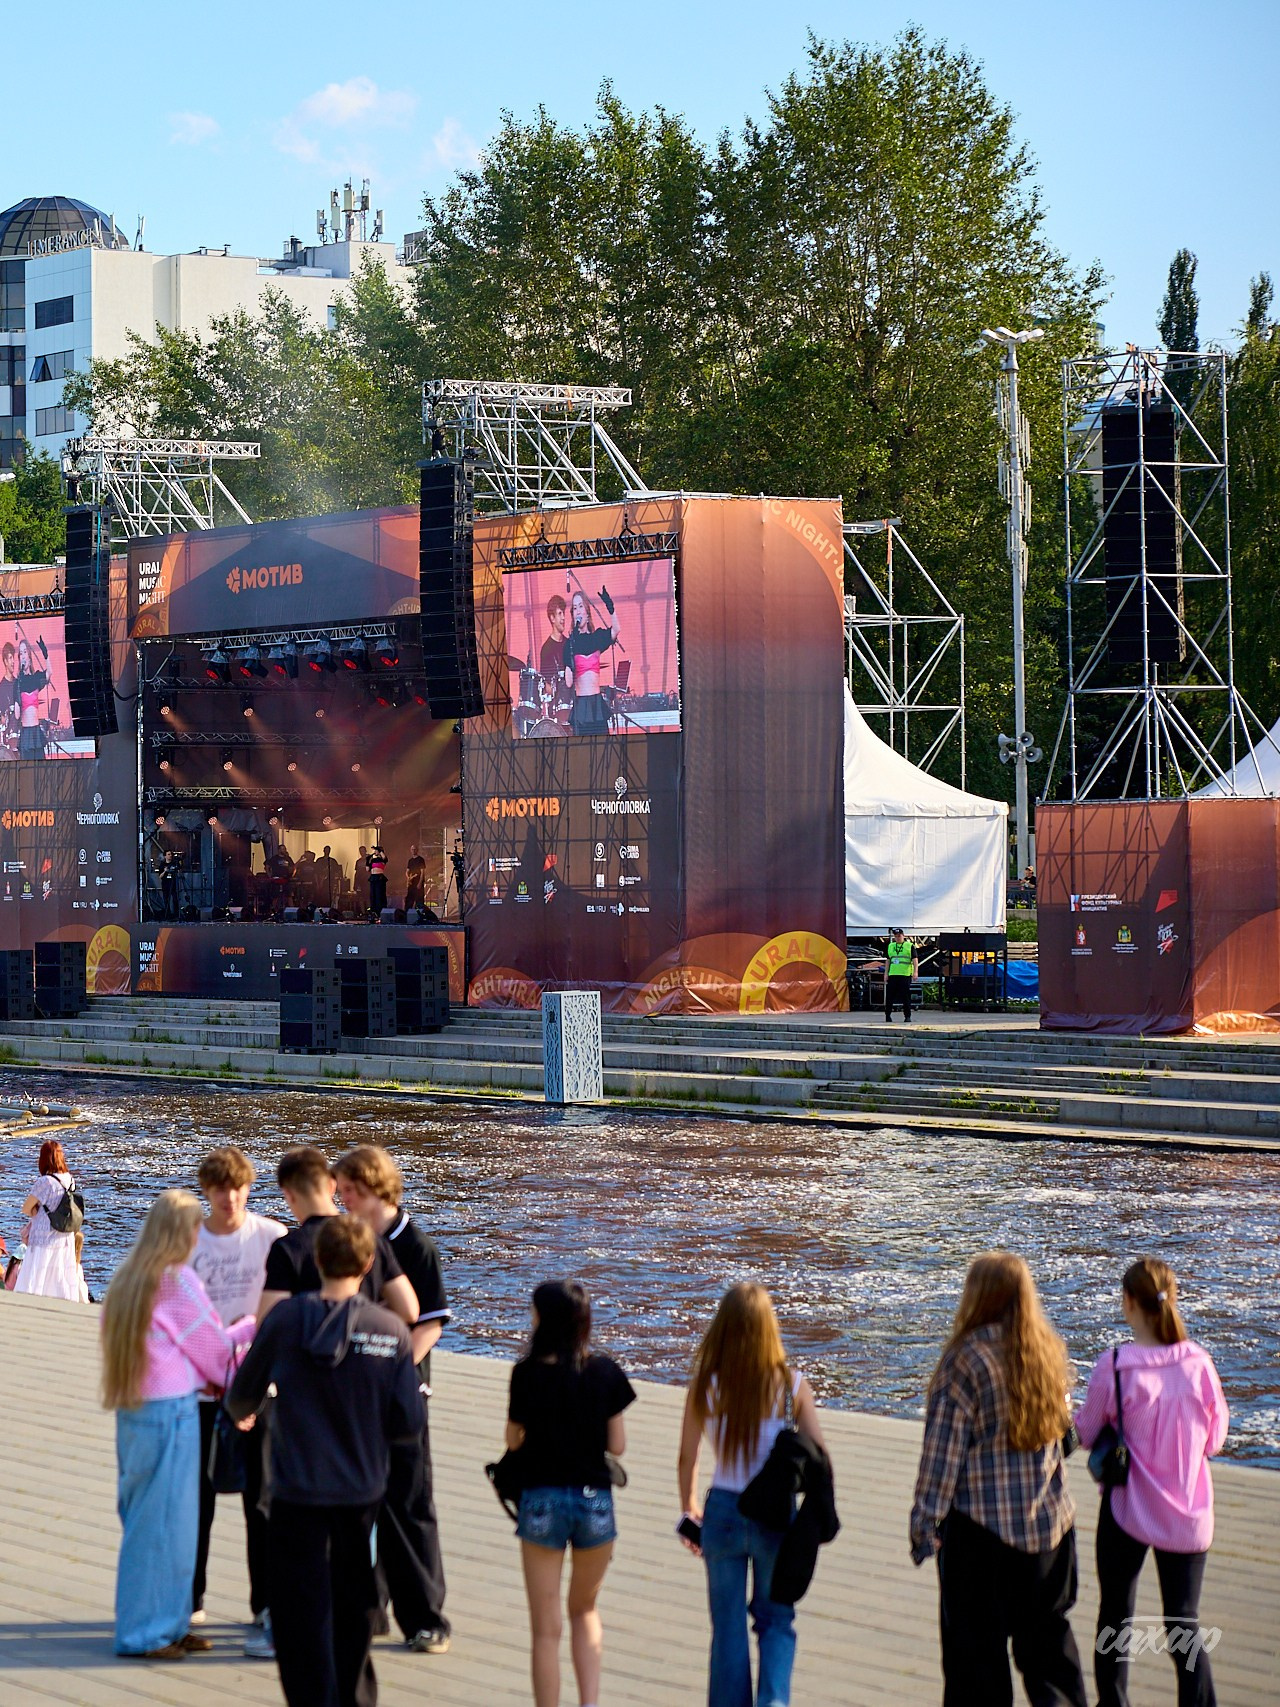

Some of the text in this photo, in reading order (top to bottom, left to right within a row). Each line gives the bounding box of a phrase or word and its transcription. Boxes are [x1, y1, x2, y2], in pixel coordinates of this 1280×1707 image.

[785, 509, 838, 560] NIGHT
[138, 561, 162, 575] URAL
[242, 563, 304, 589] МОТИВ
[138, 576, 166, 591] MUSIC
[138, 591, 166, 605] NIGHT
[501, 797, 560, 818] МОТИВ
[591, 799, 651, 815] ЧЕРНОГОЛОВКА
[11, 810, 55, 828] МОТИВ
[76, 812, 120, 825] ЧЕРНОГОЛОВКА
[89, 931, 122, 965] URAL
[224, 946, 246, 955] МОТИВ
[750, 938, 816, 980] URAL
